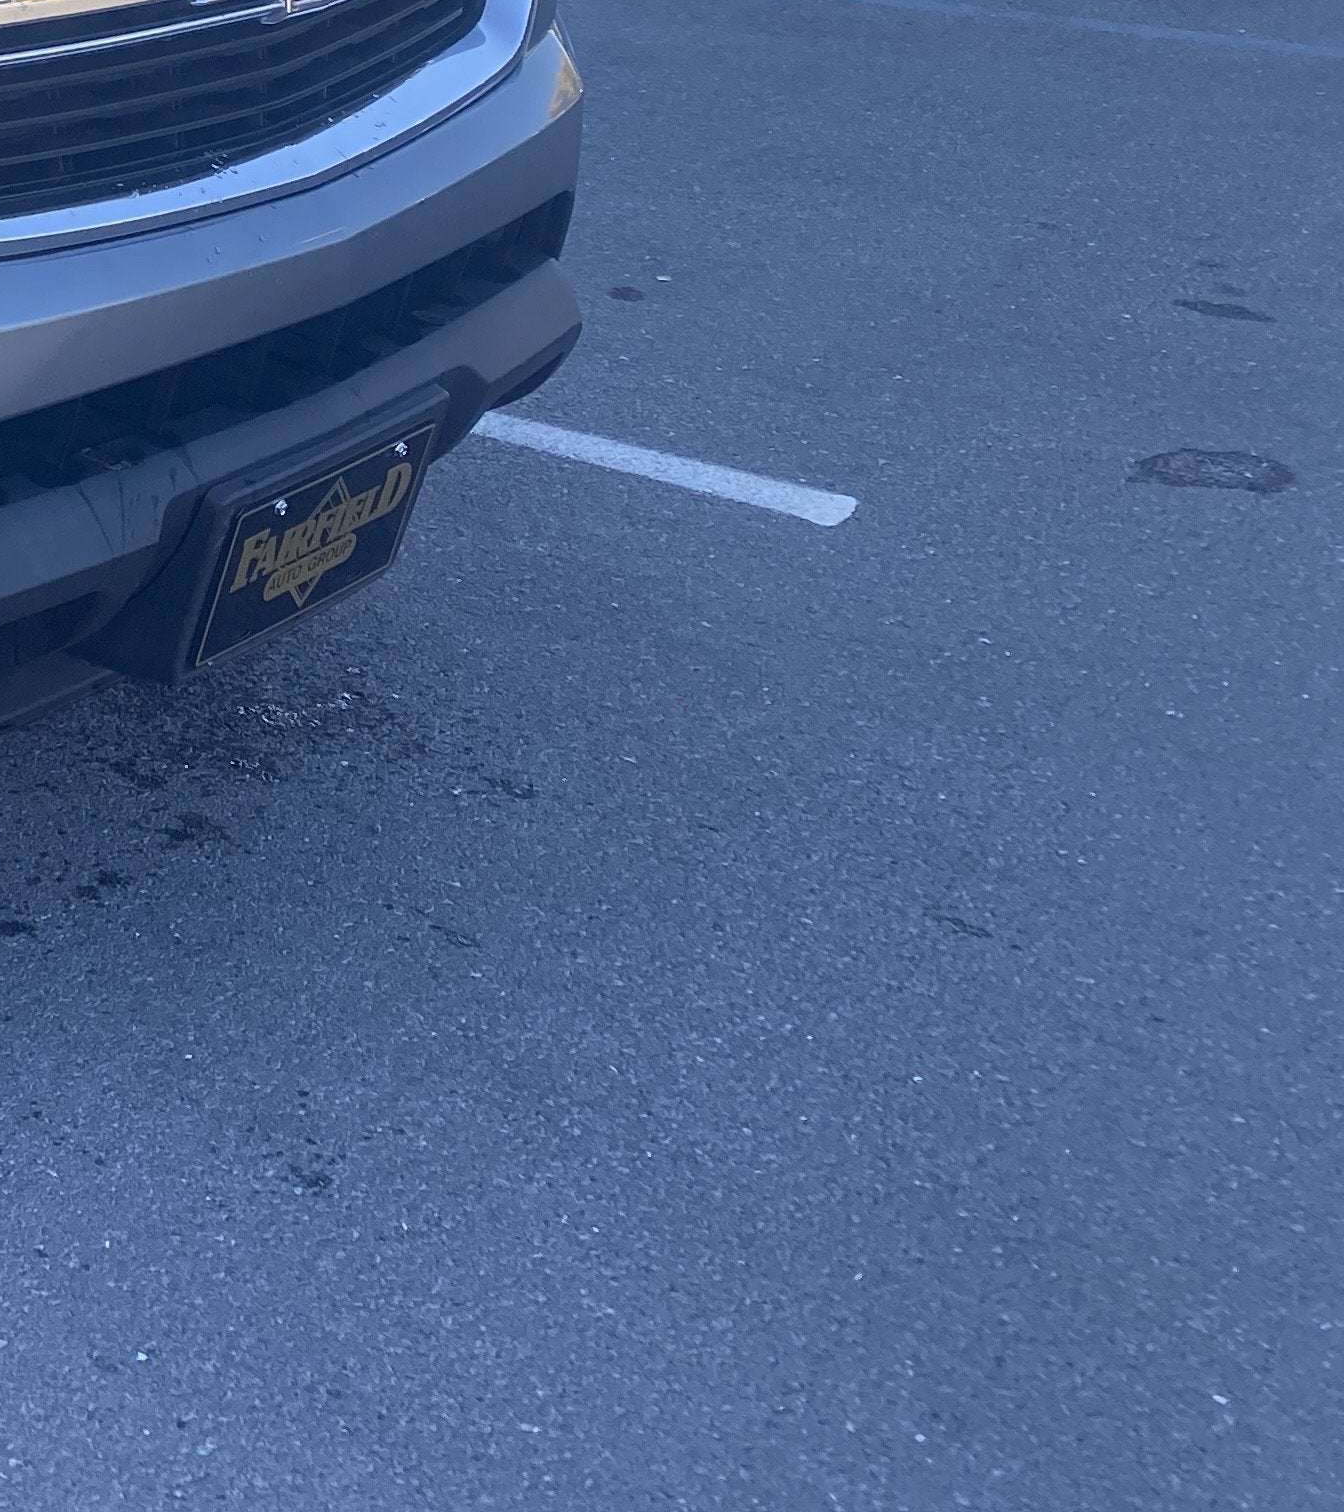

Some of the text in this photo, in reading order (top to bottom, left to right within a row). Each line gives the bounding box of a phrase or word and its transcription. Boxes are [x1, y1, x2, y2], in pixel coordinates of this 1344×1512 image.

[229, 462, 412, 594] FAIRFIELD
[268, 539, 354, 591] AUTO GROUP
